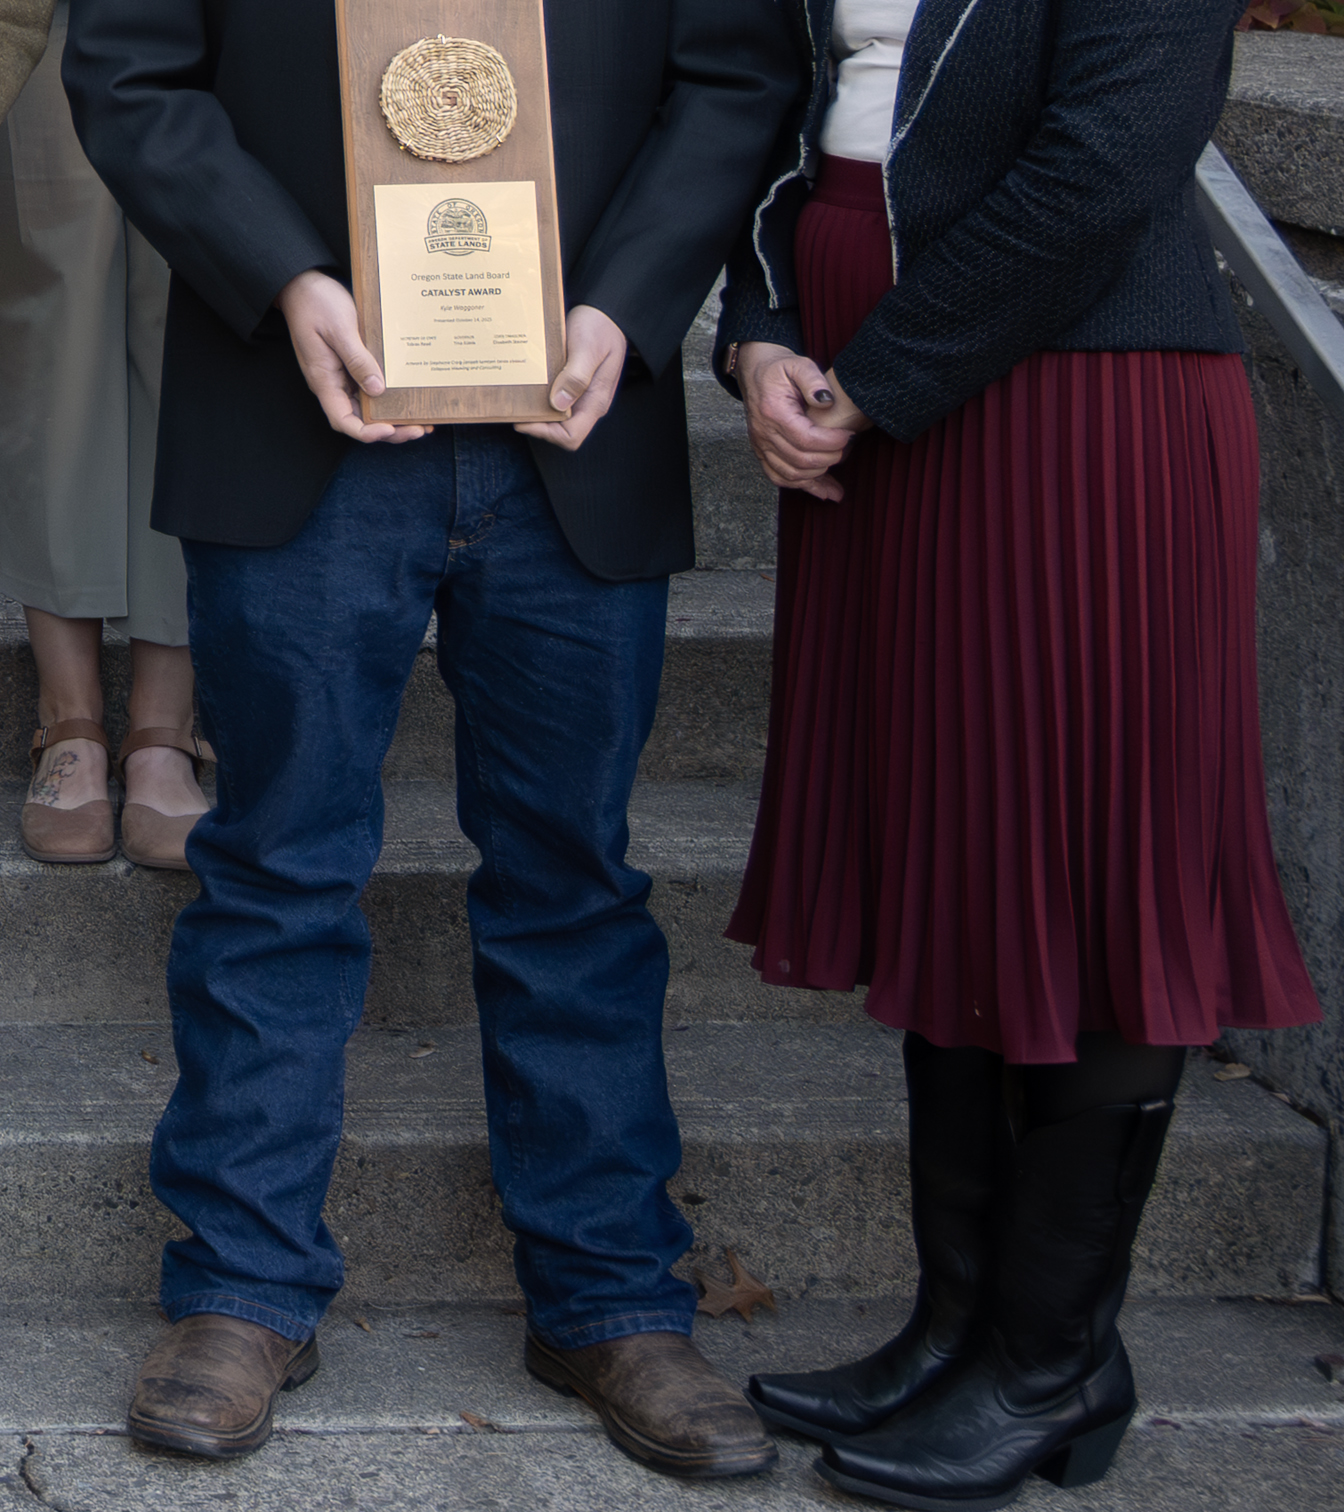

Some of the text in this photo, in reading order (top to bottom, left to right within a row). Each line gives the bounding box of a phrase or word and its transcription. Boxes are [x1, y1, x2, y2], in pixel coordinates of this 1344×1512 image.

[430, 242, 456, 250] STATE
[411, 274, 440, 282] Oregon
[421, 289, 466, 297] CATALYST
